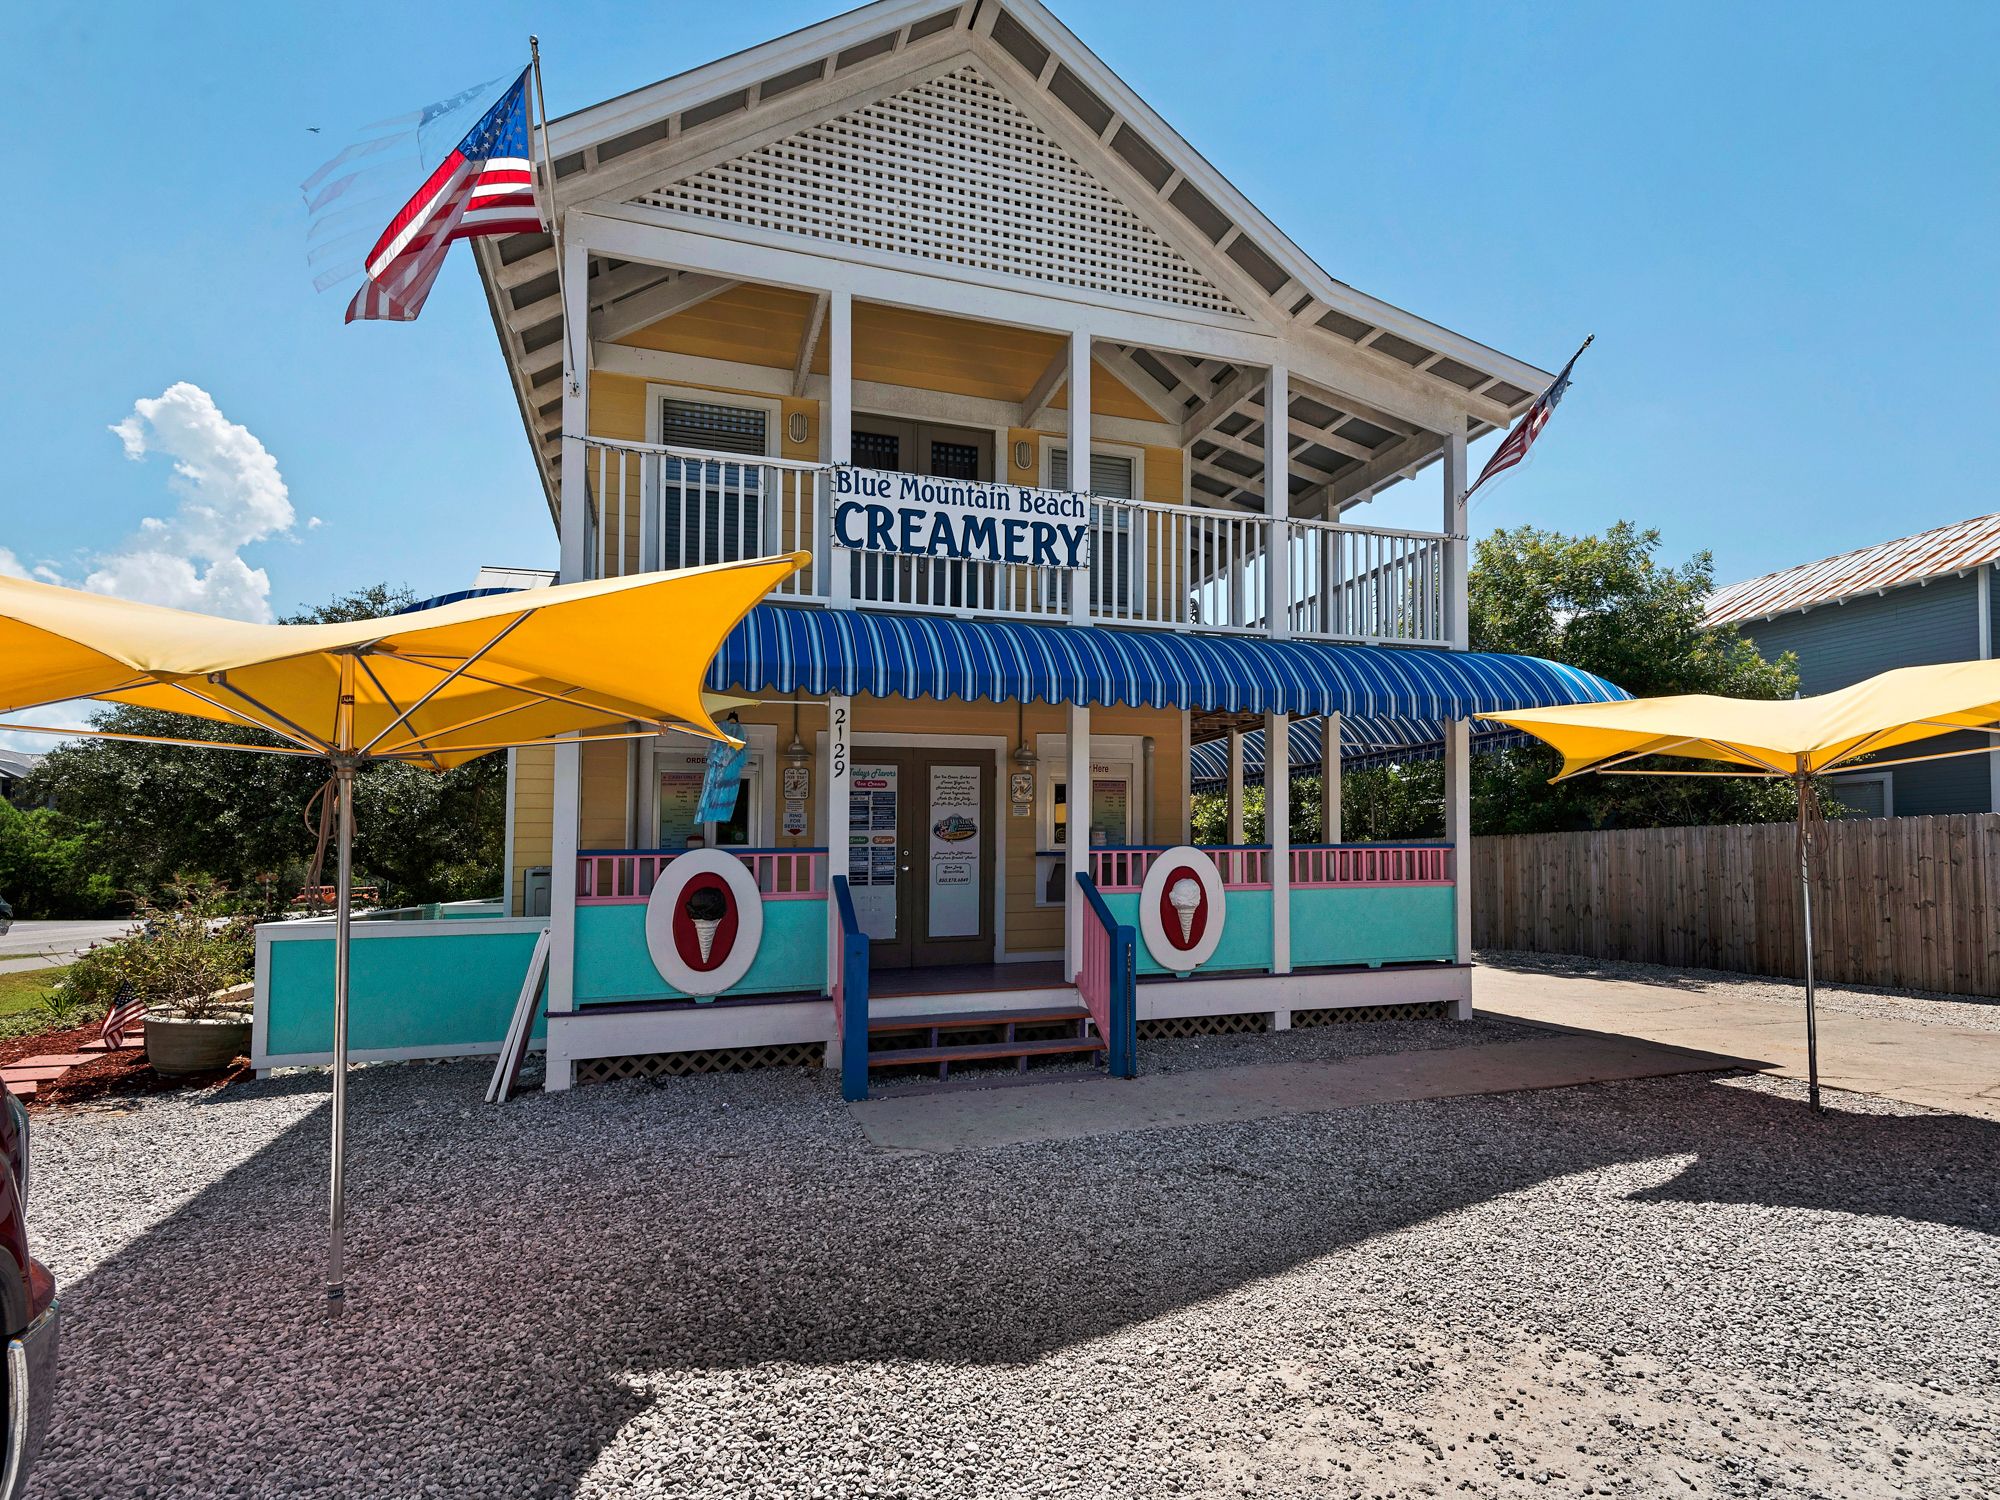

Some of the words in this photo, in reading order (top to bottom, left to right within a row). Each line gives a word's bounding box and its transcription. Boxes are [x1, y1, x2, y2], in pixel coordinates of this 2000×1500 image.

[836, 470, 891, 499] Blue
[899, 477, 1011, 511] Mountain
[1018, 490, 1085, 518] Beach
[834, 501, 1087, 567] CREAMERY
[834, 708, 846, 778] 2129
[871, 768, 896, 778] Flavors
[1092, 764, 1109, 772] Here
